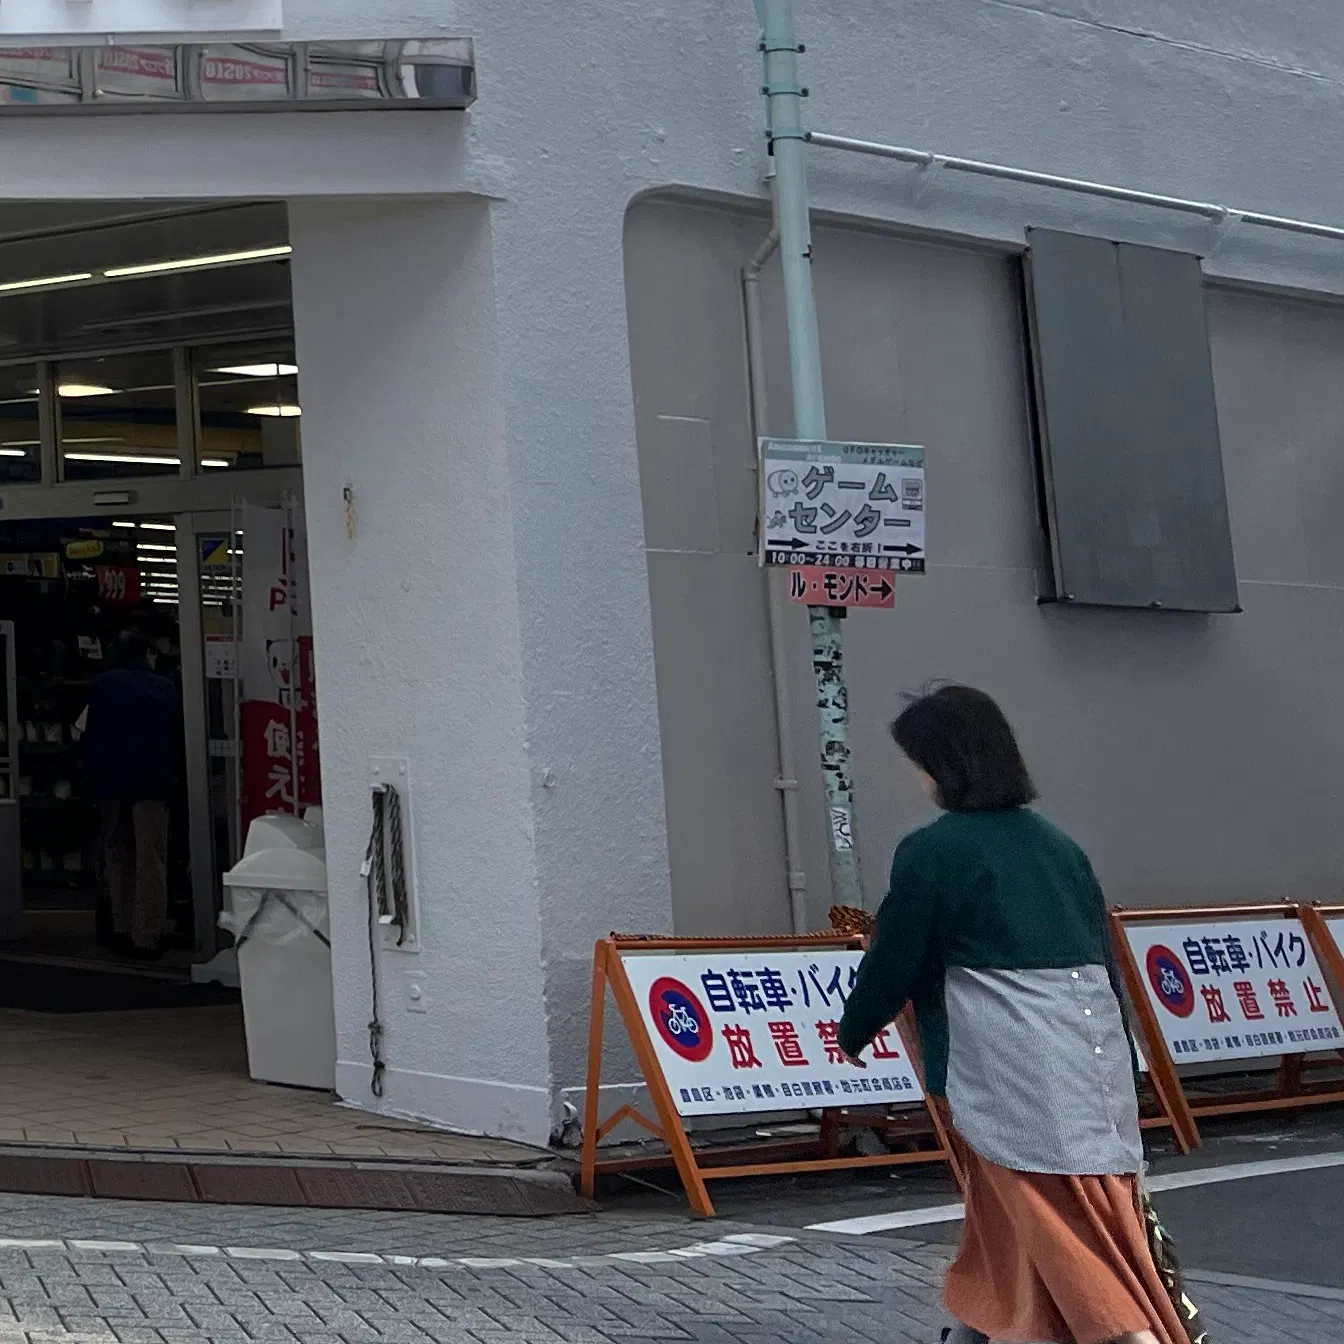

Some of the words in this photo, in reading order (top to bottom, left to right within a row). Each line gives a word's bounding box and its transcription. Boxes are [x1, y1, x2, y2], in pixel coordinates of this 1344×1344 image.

[801, 465, 899, 503] ゲーム
[787, 501, 912, 538] センター
[791, 571, 868, 602] ル・モンド
[1182, 929, 1306, 977] 自転車・バイク
[1199, 976, 1330, 1024] 放置禁止
